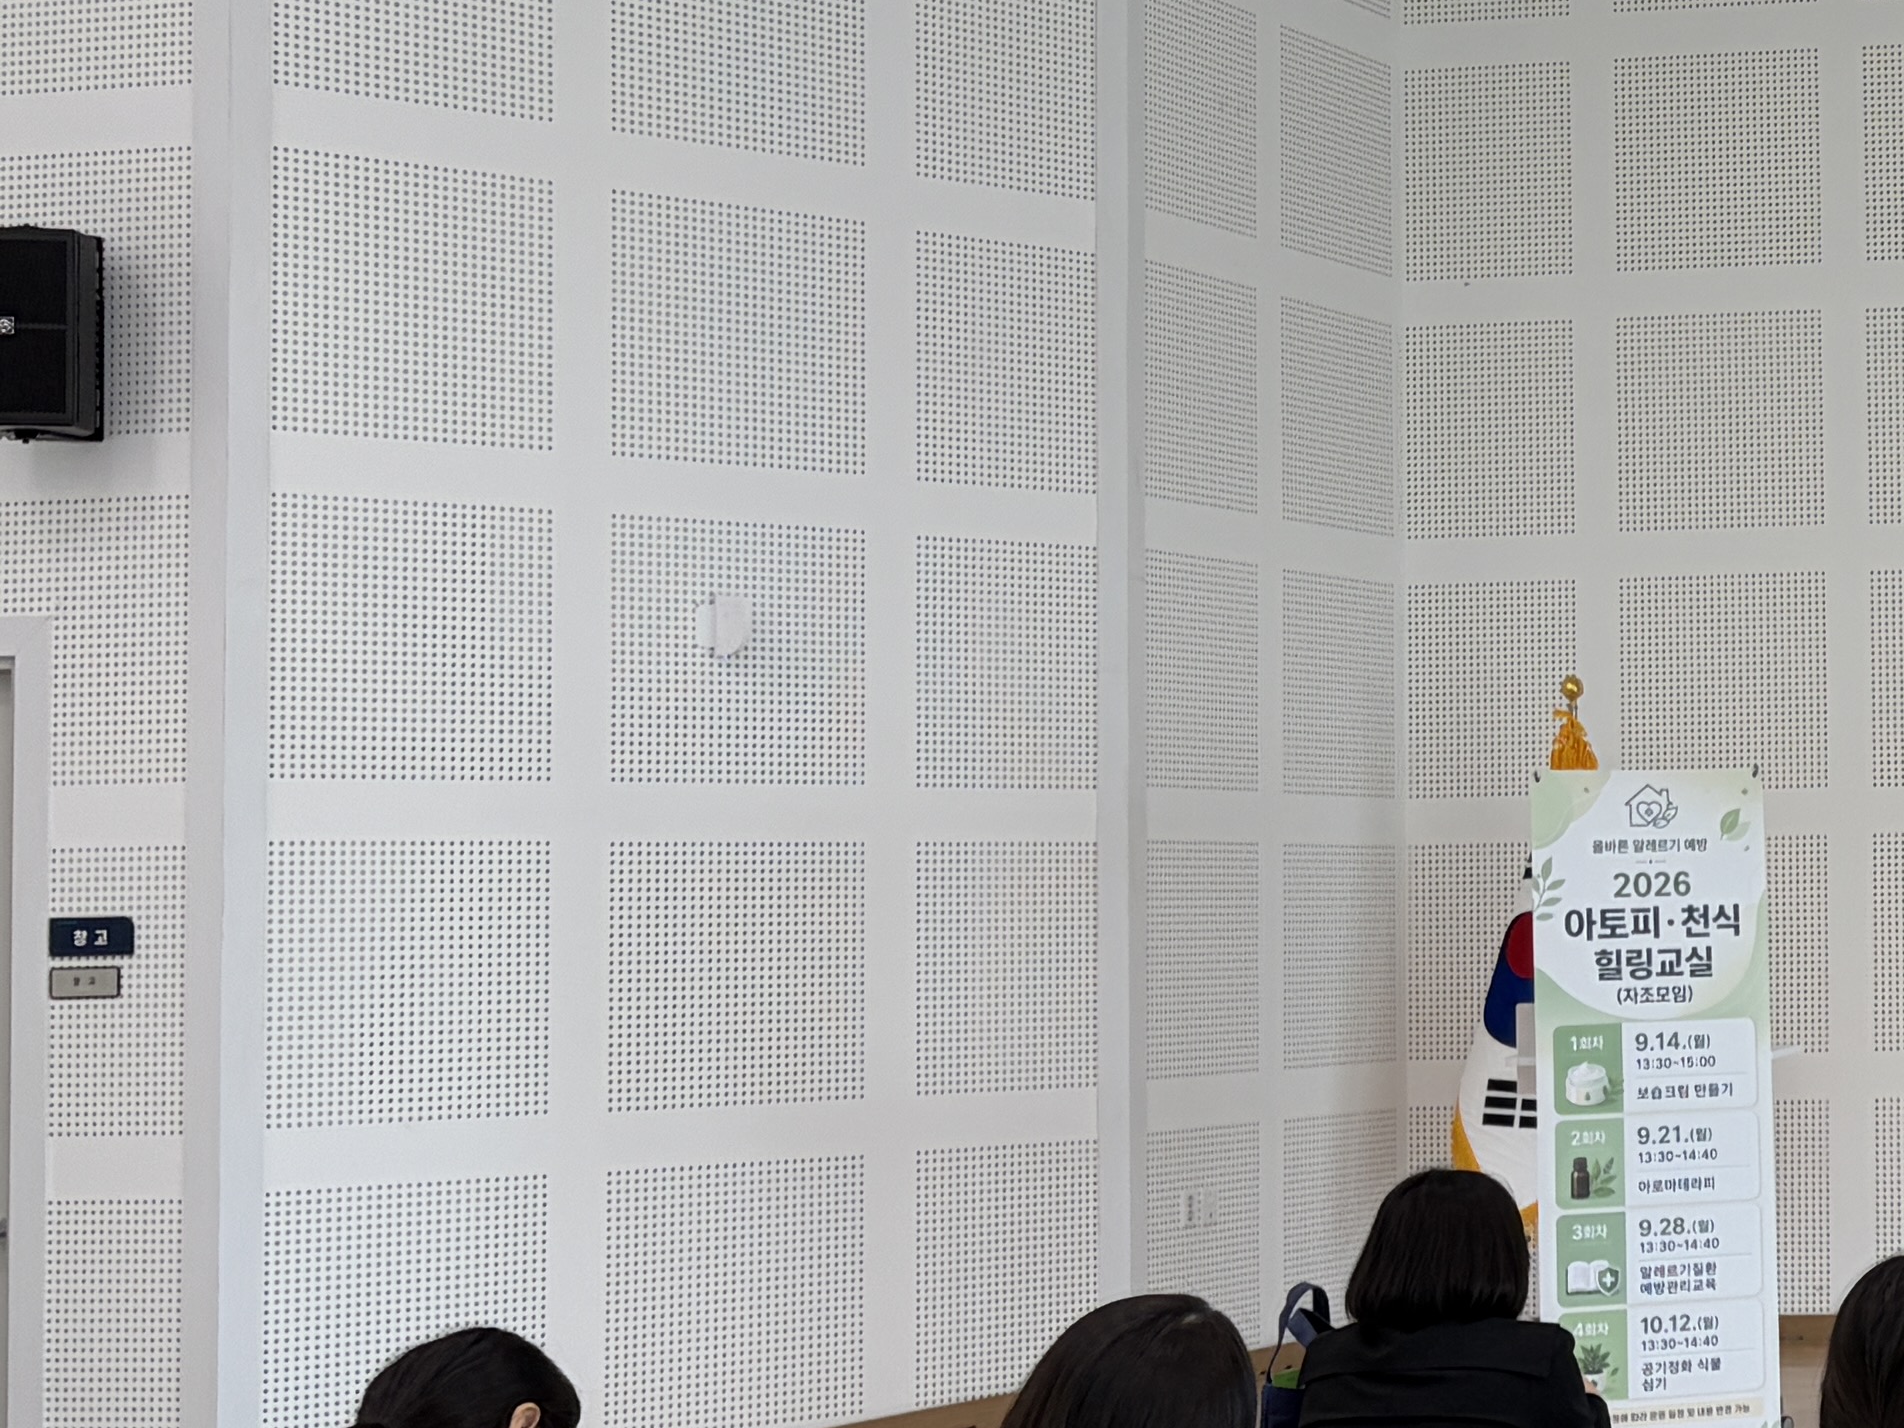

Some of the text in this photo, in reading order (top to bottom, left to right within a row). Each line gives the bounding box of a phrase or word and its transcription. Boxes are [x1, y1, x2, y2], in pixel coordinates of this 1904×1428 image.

[1633, 838, 1681, 853] 알레르기
[1684, 838, 1708, 853] 예방
[1613, 871, 1691, 898] 2026
[1564, 903, 1741, 941] 아토피·천식
[1594, 945, 1714, 982] 힐링교실
[1616, 985, 1694, 1006] (자조모임)
[1635, 1031, 1711, 1052] 9.14.(월)
[1637, 1125, 1713, 1145] 9.21.(월)
[1638, 1148, 1718, 1164] 13:30~14:40
[1638, 1176, 1715, 1193] 아로마테라피
[1638, 1217, 1715, 1237] 9.28.(월)
[1640, 1237, 1720, 1253] 13:30~14:40
[1640, 1261, 1717, 1279] 알레르기질환
[1640, 1278, 1717, 1295] 예방관리교육
[1640, 1314, 1719, 1334] 10.12.(월)
[1641, 1335, 1719, 1351] 13:30~14:40
[1641, 1357, 1721, 1376] 공기정화 식물
